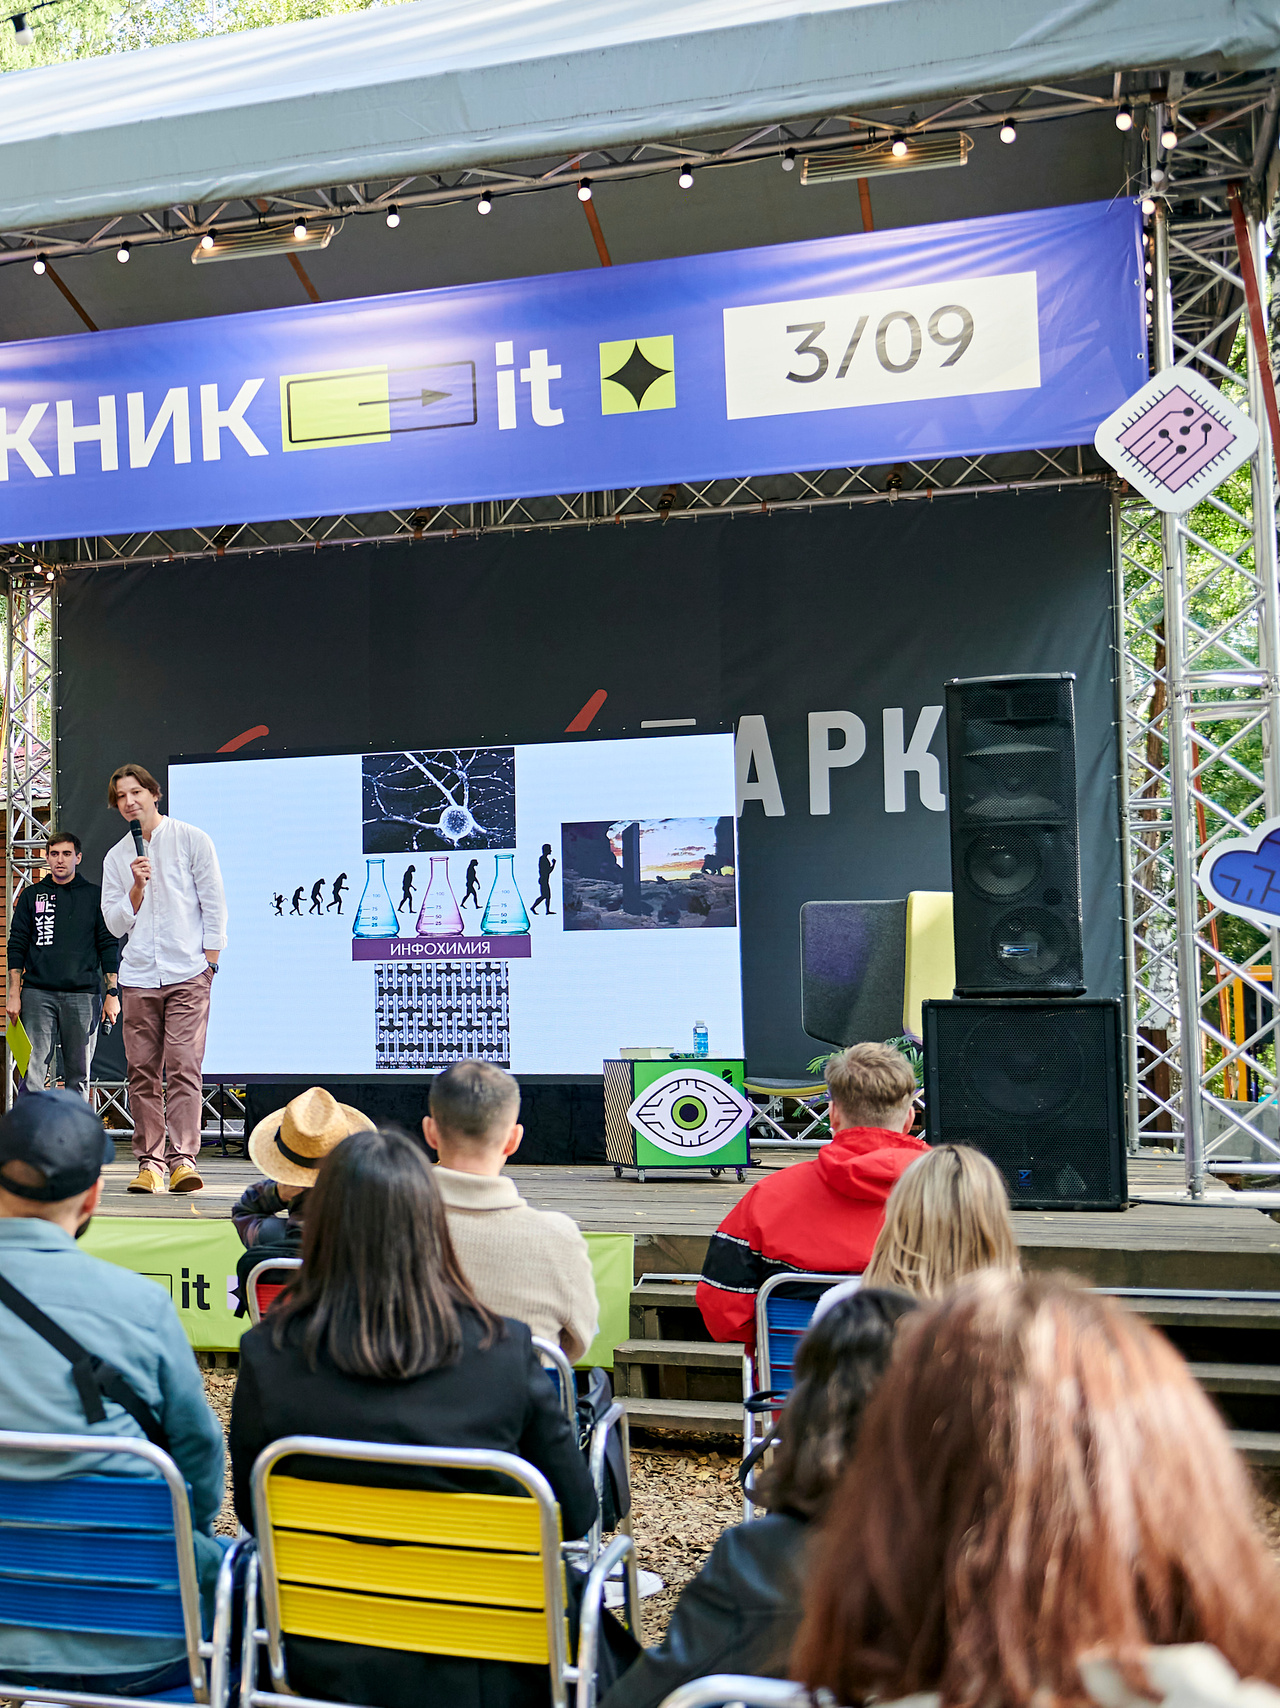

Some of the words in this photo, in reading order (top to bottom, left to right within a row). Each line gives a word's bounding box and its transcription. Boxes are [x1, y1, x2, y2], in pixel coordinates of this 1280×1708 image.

[784, 304, 975, 384] 3/09
[494, 340, 565, 431] it
[640, 705, 946, 817] АРК
[44, 915, 55, 945] НИК
[390, 941, 491, 956] ИНФОХИМИЯ
[181, 1267, 210, 1310] it
